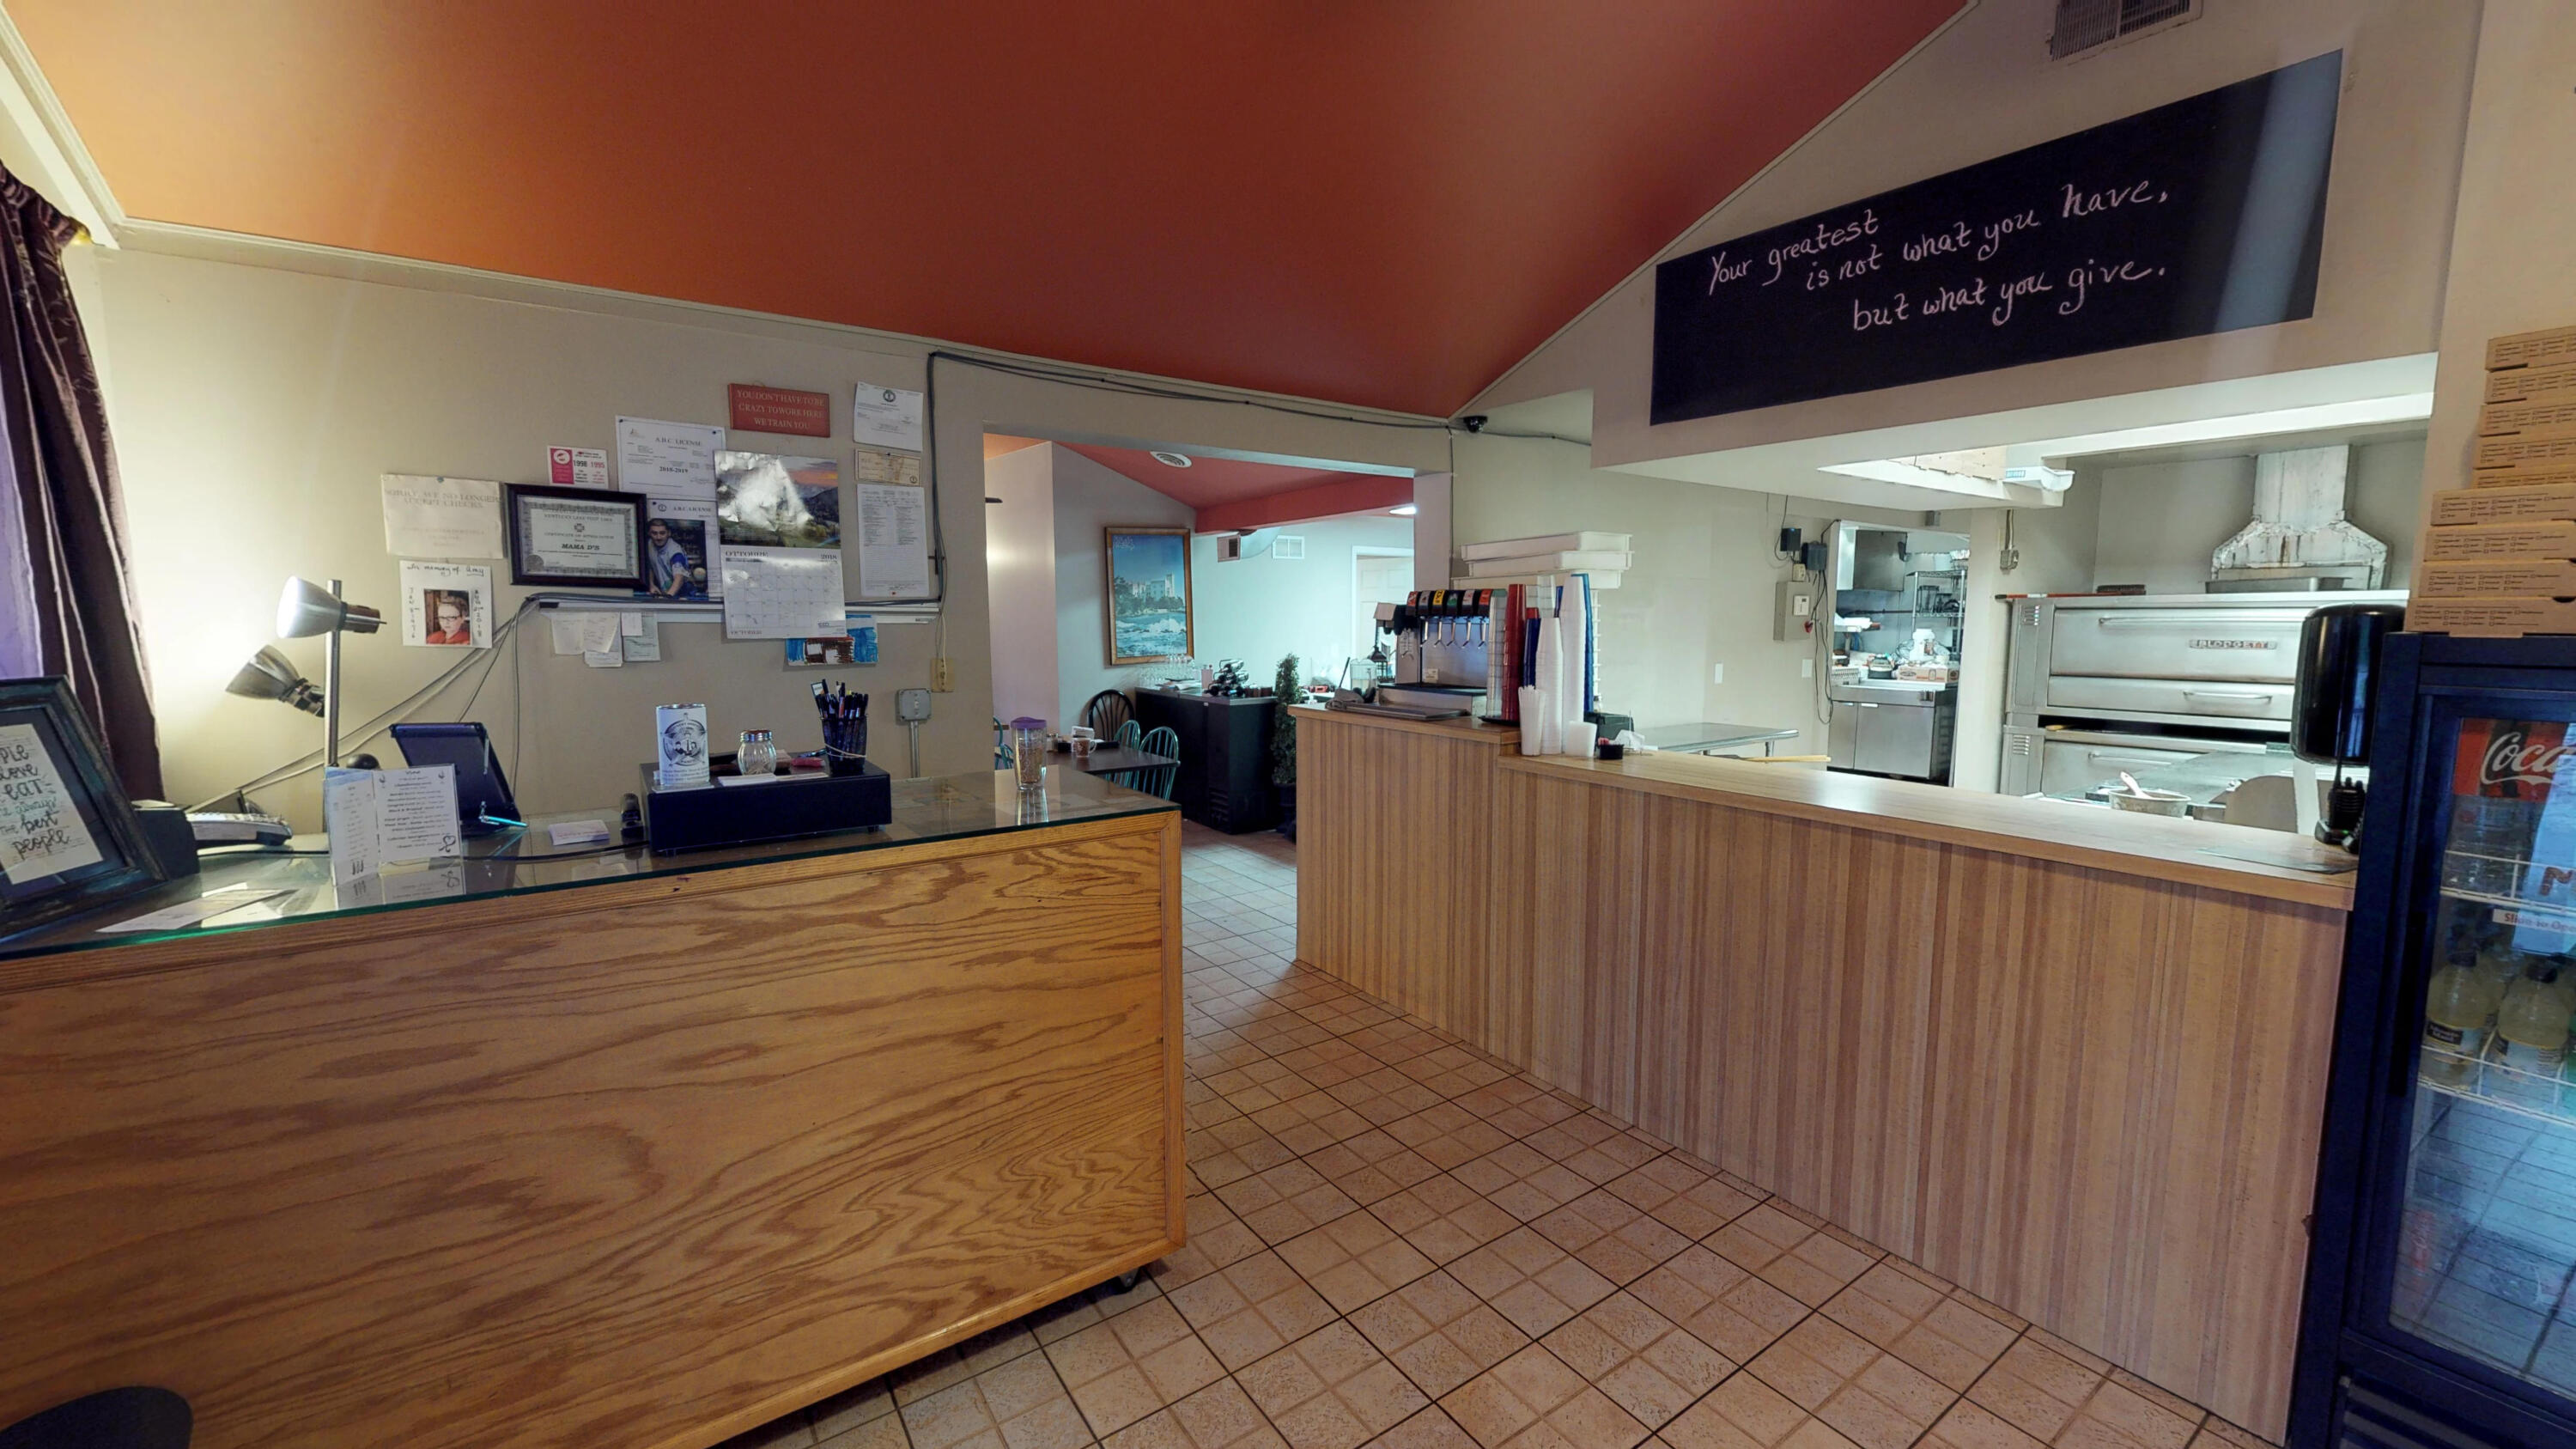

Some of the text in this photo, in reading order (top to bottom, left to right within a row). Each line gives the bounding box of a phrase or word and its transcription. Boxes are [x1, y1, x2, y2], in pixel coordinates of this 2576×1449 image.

[1709, 209, 1880, 296] Your greatest
[1806, 261, 1830, 291] is
[1839, 244, 1883, 281] not
[1903, 222, 1971, 262] what
[1978, 210, 2041, 261] you
[1853, 293, 1909, 332] but
[1923, 278, 1987, 315] what
[1992, 272, 2052, 326] you
[781, 394, 801, 404] HAVE
[815, 398, 825, 406] BE
[738, 403, 825, 418] CRAZY TO WORK HERE
[753, 417, 811, 429] WE TRAIN YOU
[459, 493, 502, 503] LONGER
[423, 565, 452, 577] memory
[452, 566, 460, 575] of
[12, 828, 70, 861] people
